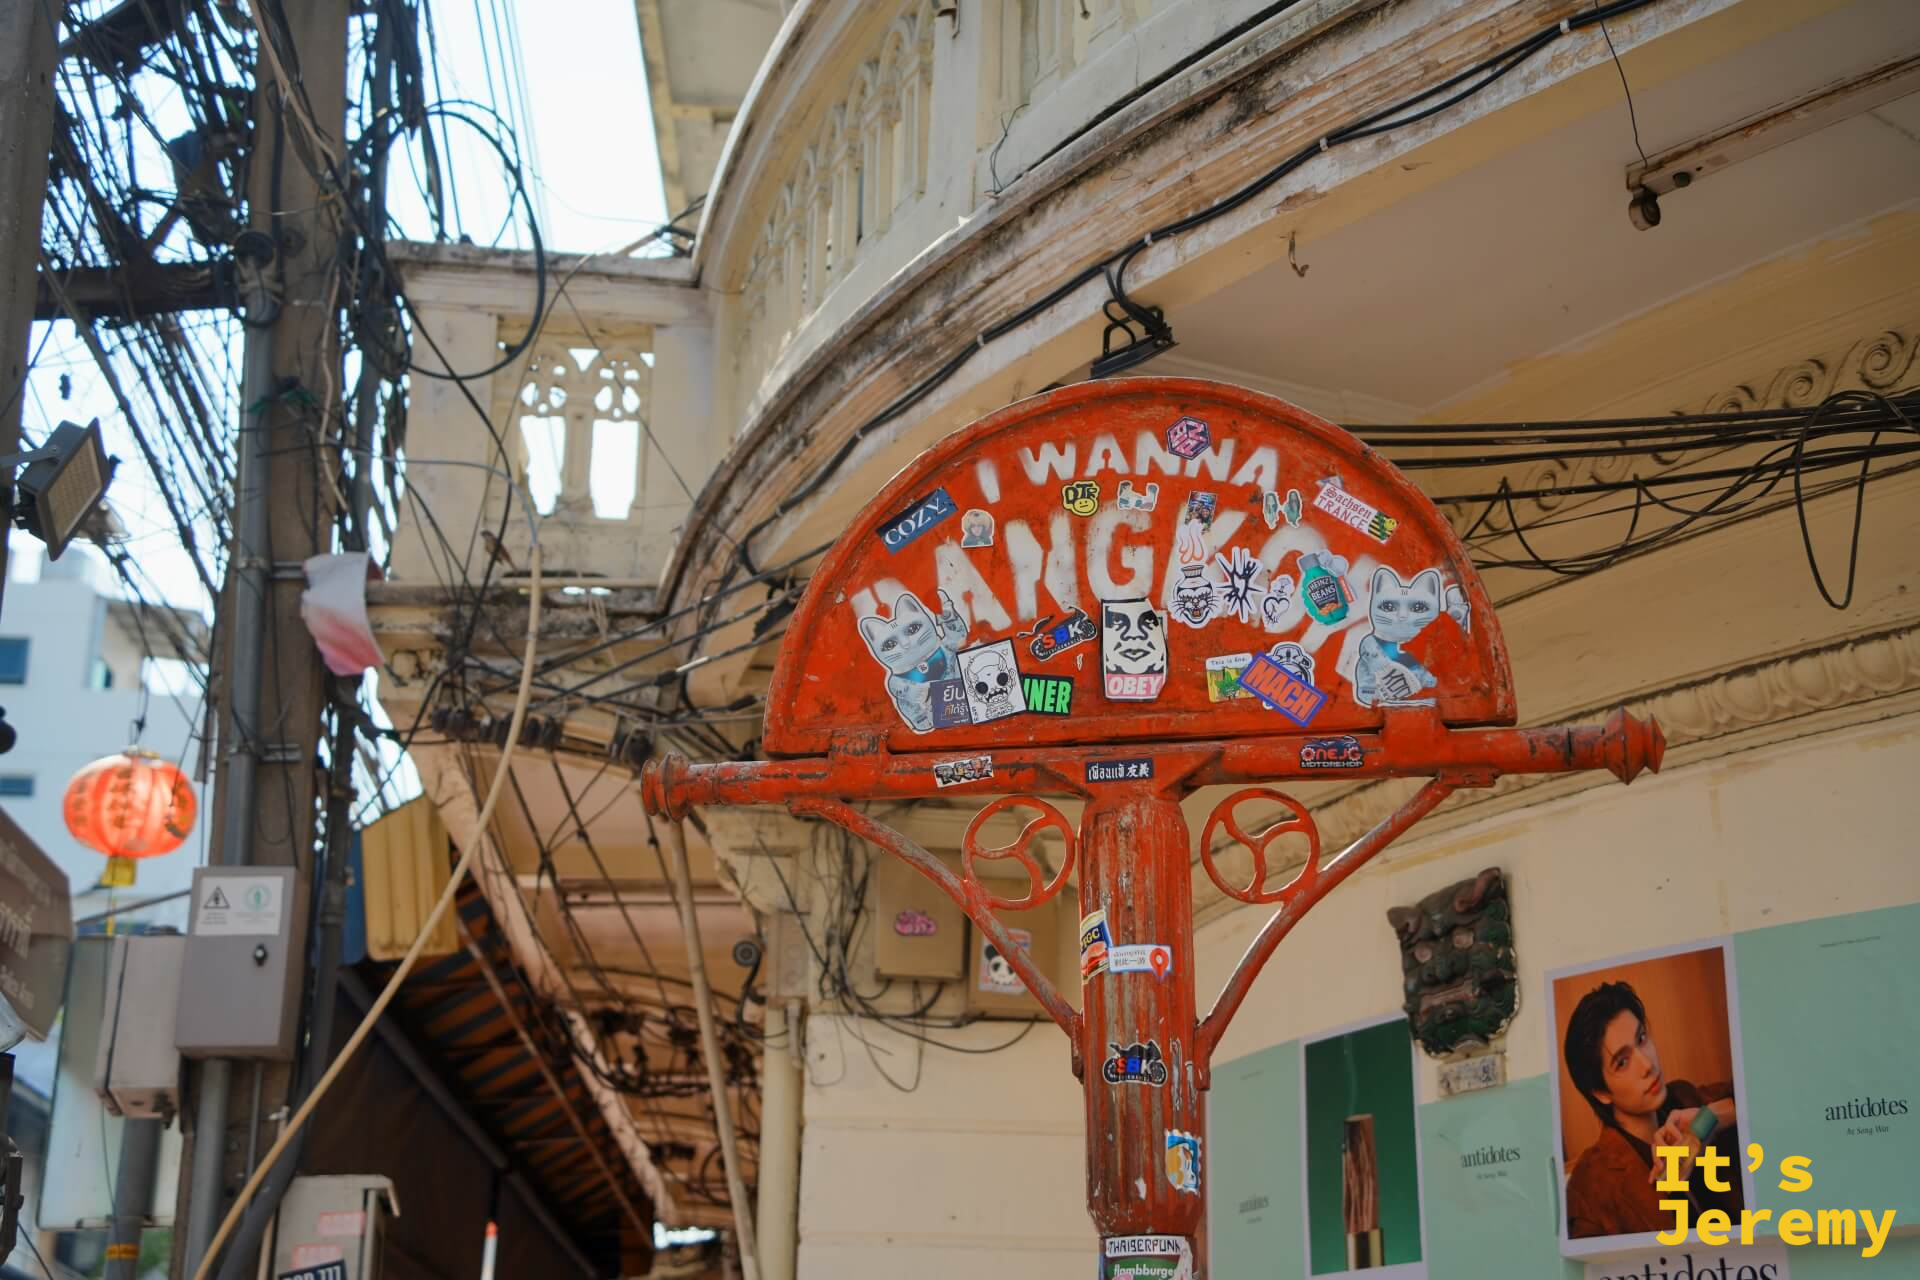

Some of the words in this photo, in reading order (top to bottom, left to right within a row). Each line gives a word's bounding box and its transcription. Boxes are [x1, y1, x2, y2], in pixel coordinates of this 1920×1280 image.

[976, 458, 1001, 504] I
[1017, 430, 1280, 494] WANNA
[884, 496, 949, 547] COZY
[1318, 495, 1369, 529] TRANCE
[1309, 578, 1330, 591] HEINZ
[1311, 585, 1336, 600] BEANS
[1108, 676, 1162, 695] OBEY
[1244, 658, 1320, 721] MACH
[1825, 1097, 1908, 1121] antidotes
[1461, 1145, 1521, 1169] antidotes
[1600, 1252, 1778, 1280] tidotes
